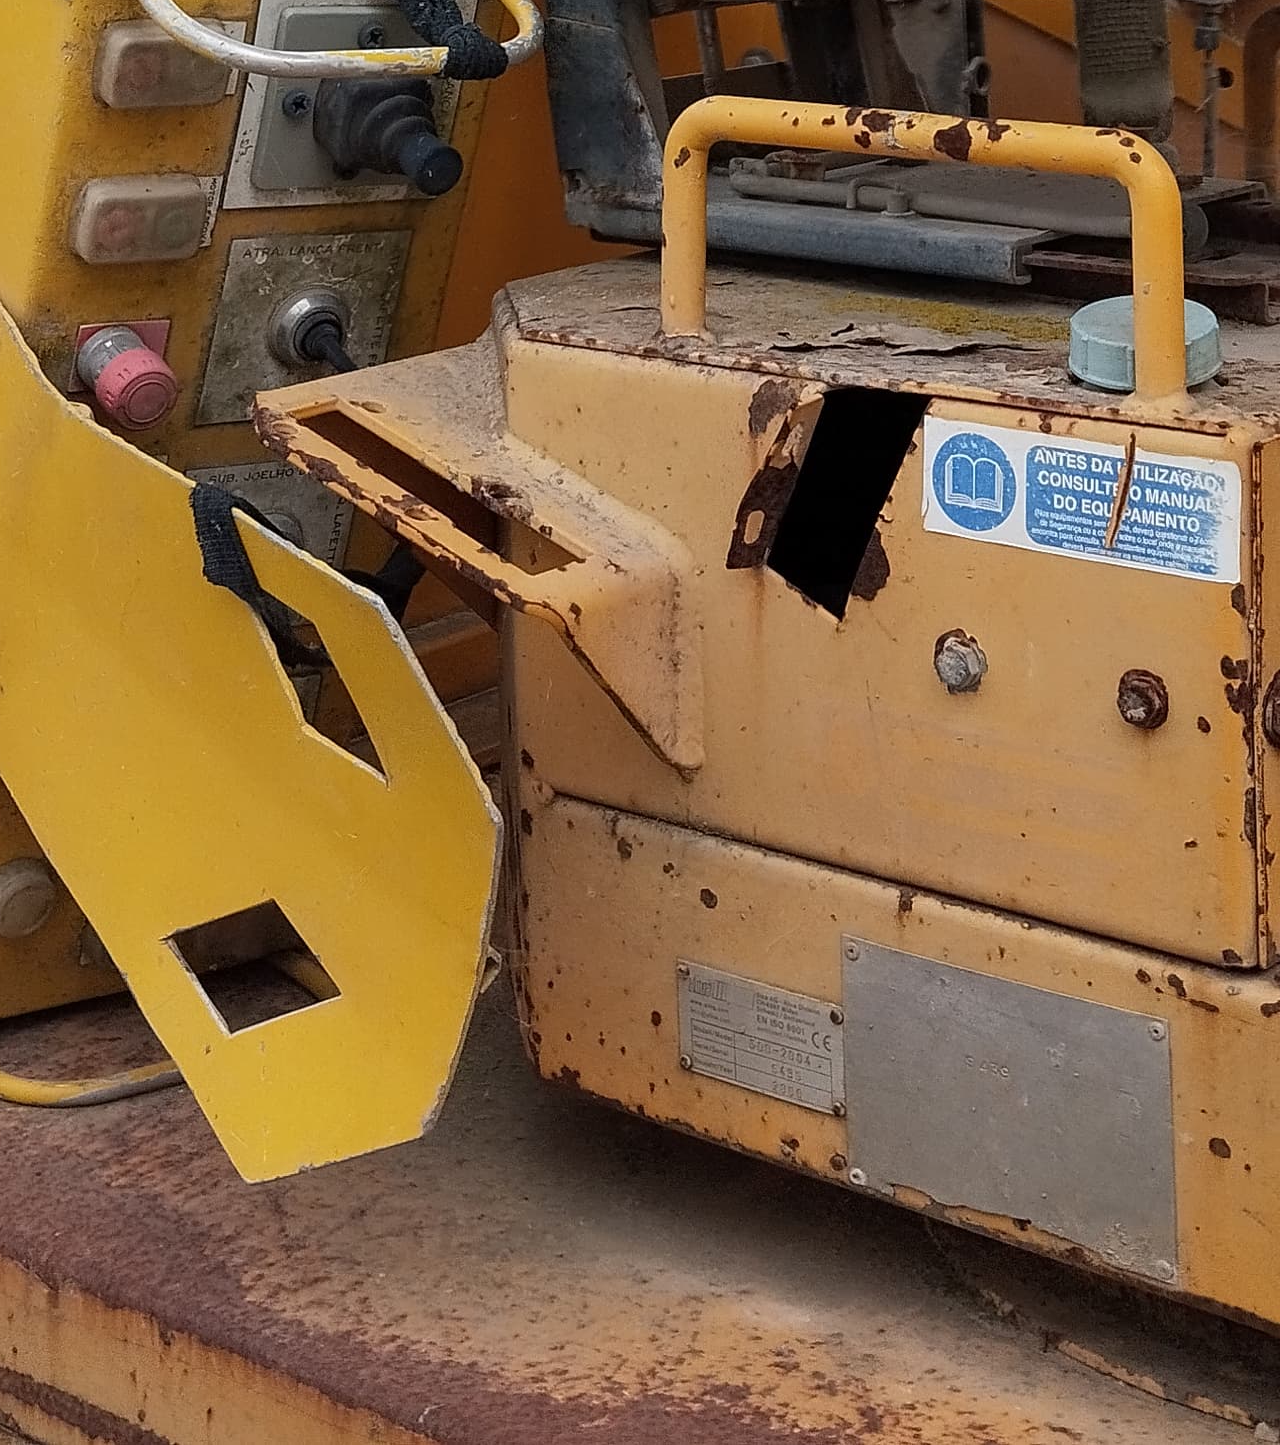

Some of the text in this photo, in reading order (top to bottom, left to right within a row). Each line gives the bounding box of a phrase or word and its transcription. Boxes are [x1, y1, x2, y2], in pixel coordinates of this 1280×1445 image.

[244, 468, 295, 482] JOELHO
[1034, 448, 1087, 470] ANTES
[1091, 457, 1114, 475] DA
[1130, 485, 1141, 501] O
[1145, 488, 1215, 513] MANUAL
[1053, 494, 1200, 533] DO EQUPAMENTO
